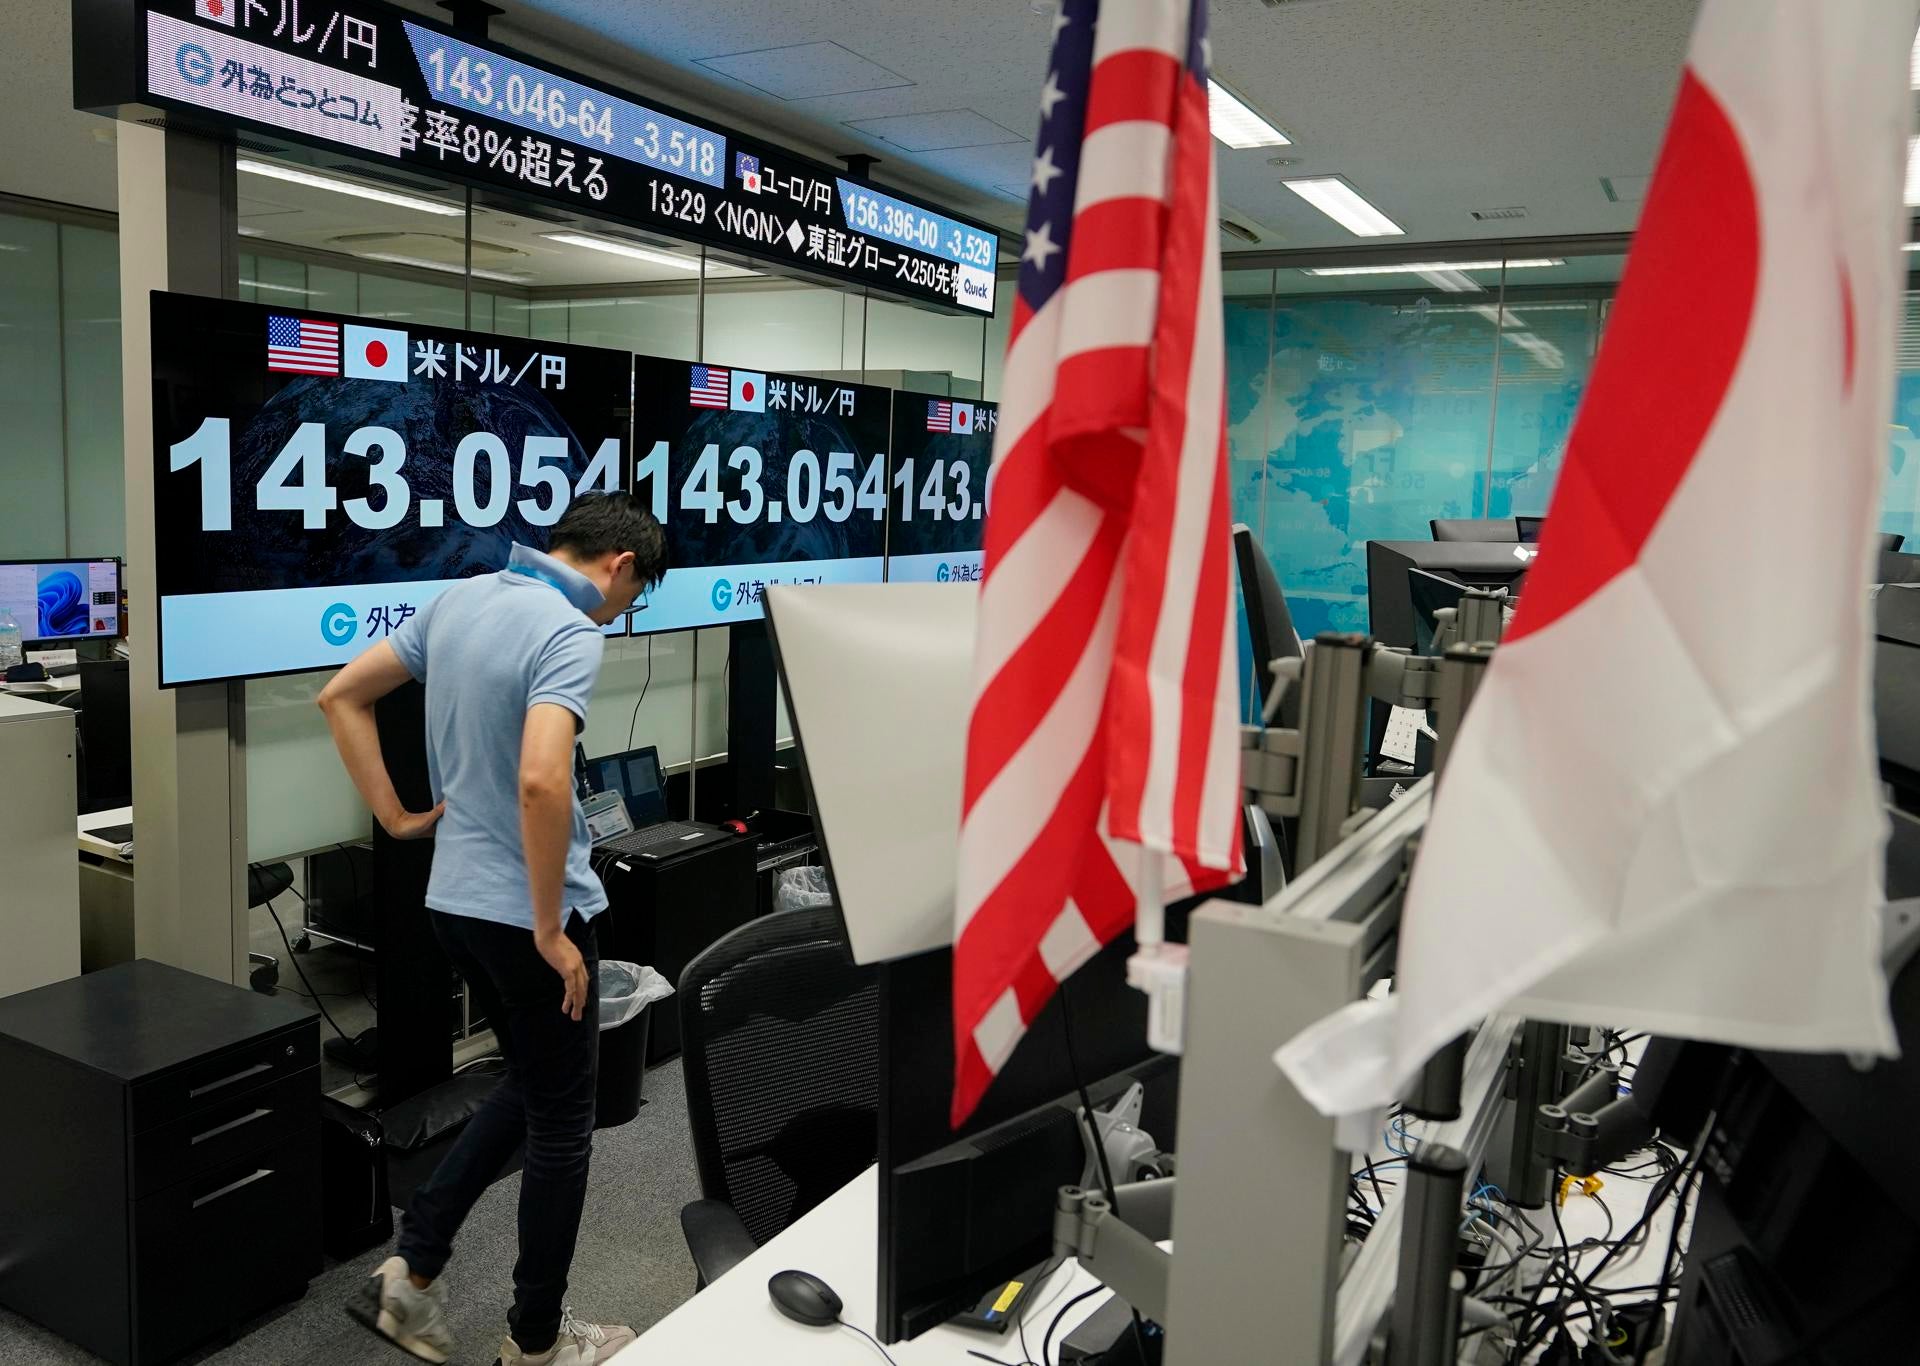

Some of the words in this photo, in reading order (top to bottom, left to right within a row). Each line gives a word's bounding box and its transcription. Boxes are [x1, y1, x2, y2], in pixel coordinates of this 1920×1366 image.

[219, 58, 382, 130] 外為どっとコム
[428, 47, 614, 145] 143.046-64
[634, 121, 715, 177] -3.518
[649, 180, 706, 225] 13:29
[762, 166, 832, 215] ユーロ/円
[847, 192, 938, 249] 156.396-00
[947, 229, 991, 266] -3.529
[414, 338, 566, 390] 米ドル／円
[768, 379, 855, 416] 米ドル／円
[170, 417, 620, 531] 143.054
[637, 441, 887, 525] 143.054
